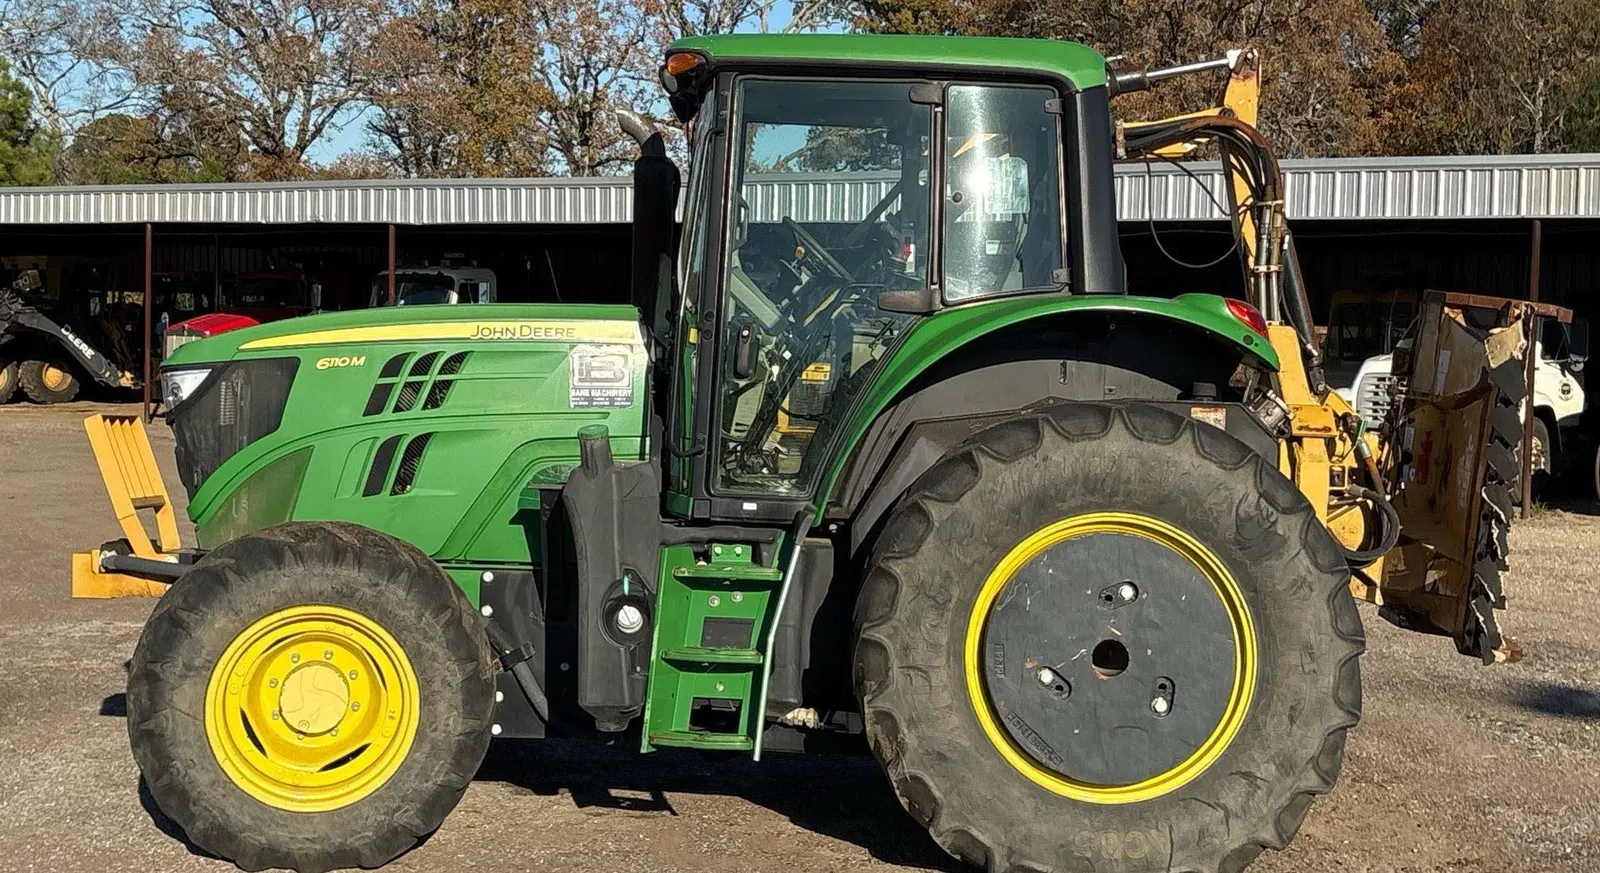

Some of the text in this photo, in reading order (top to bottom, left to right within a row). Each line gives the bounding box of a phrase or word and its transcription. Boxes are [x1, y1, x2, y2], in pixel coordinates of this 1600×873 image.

[470, 325, 577, 338] JOHN DEERE
[61, 324, 96, 360] DEERE
[316, 356, 366, 370] 6110M
